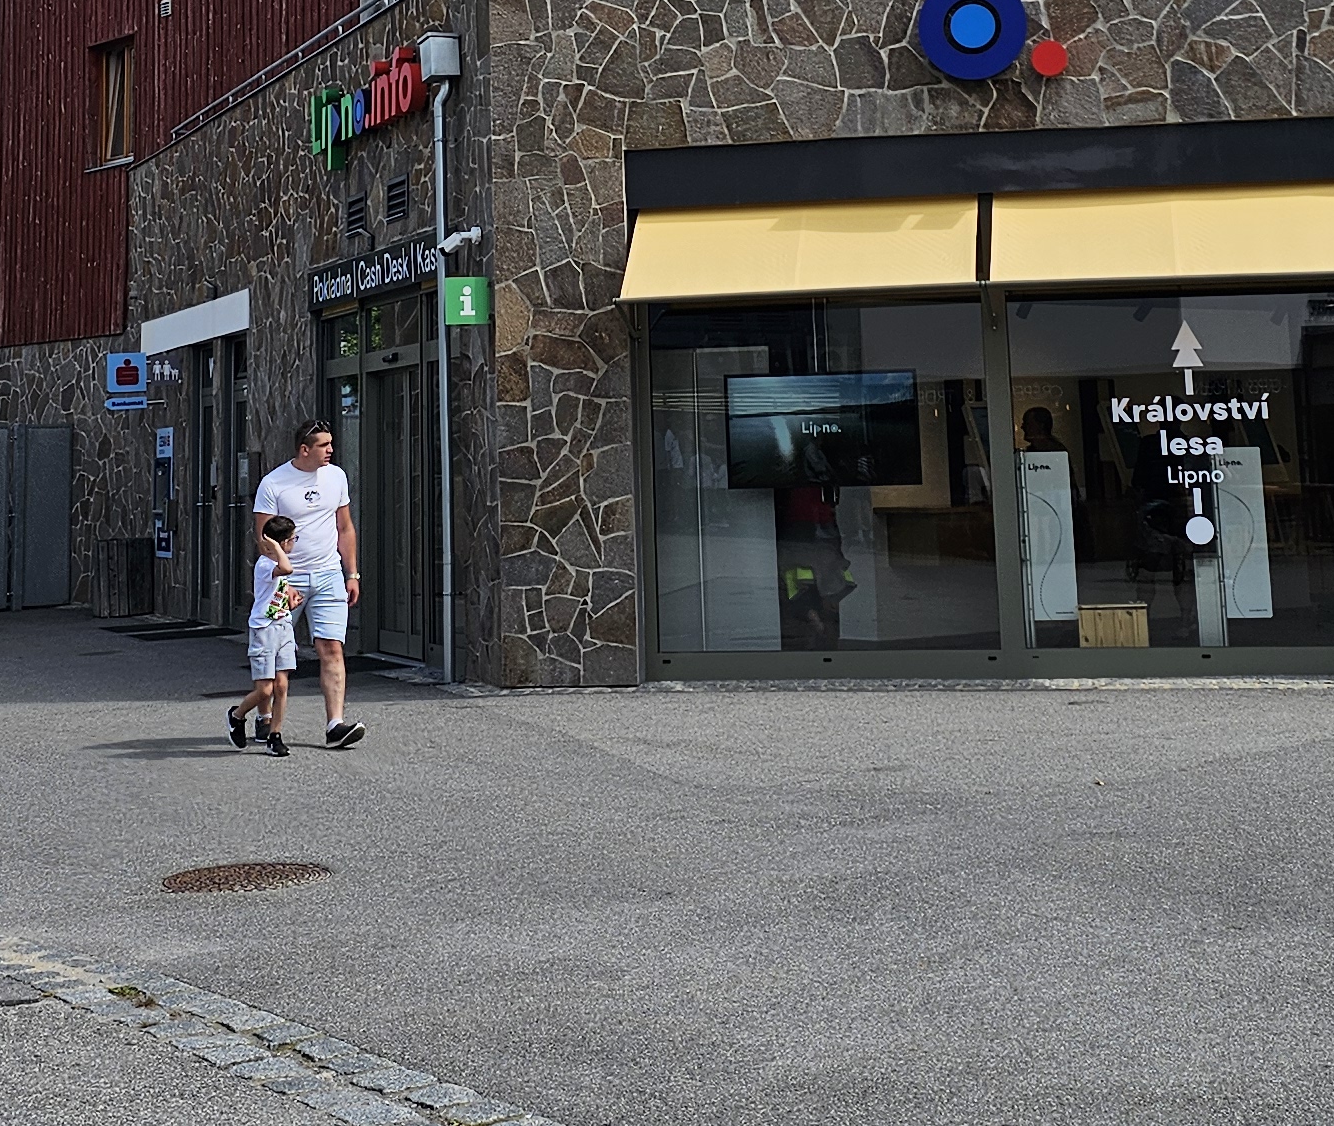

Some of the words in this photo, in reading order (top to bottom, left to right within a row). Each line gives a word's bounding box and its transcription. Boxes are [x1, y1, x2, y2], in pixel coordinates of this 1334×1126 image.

[313, 268, 352, 304] Pokladna
[357, 256, 382, 291] Cash
[383, 247, 410, 284] Desk
[1111, 392, 1270, 423] Království
[1159, 429, 1225, 456] lesa
[1167, 465, 1225, 489] Lipno
